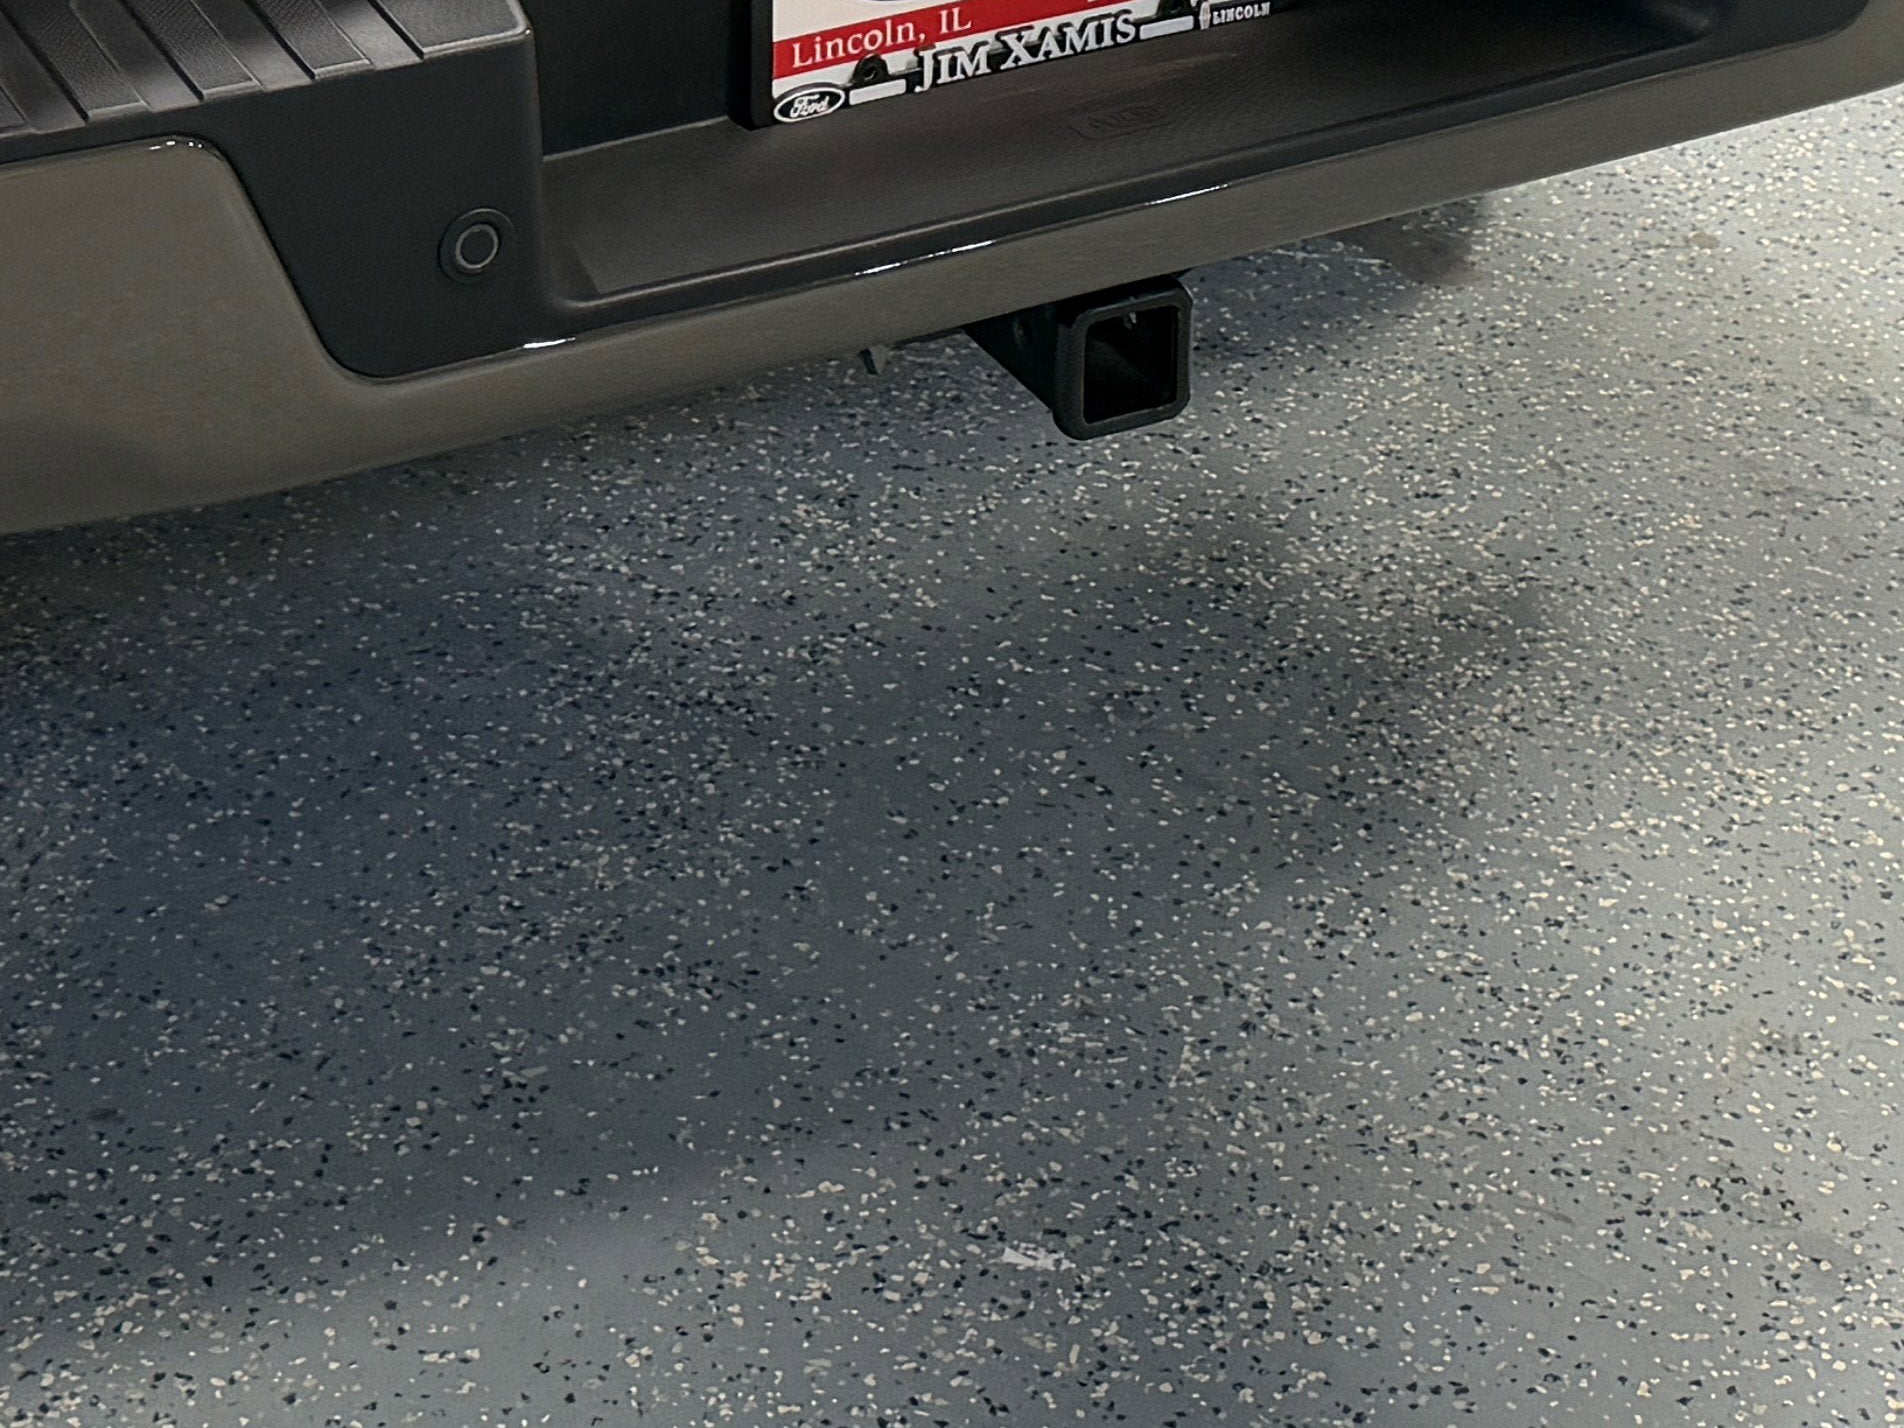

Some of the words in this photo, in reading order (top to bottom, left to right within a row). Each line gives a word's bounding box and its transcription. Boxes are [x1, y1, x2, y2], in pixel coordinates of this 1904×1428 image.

[792, 19, 926, 68] Lincoln,
[939, 6, 972, 35] IL
[1212, 1, 1271, 25] LINCOLN
[914, 44, 992, 93] JIM
[1000, 13, 1138, 70] XAMIS
